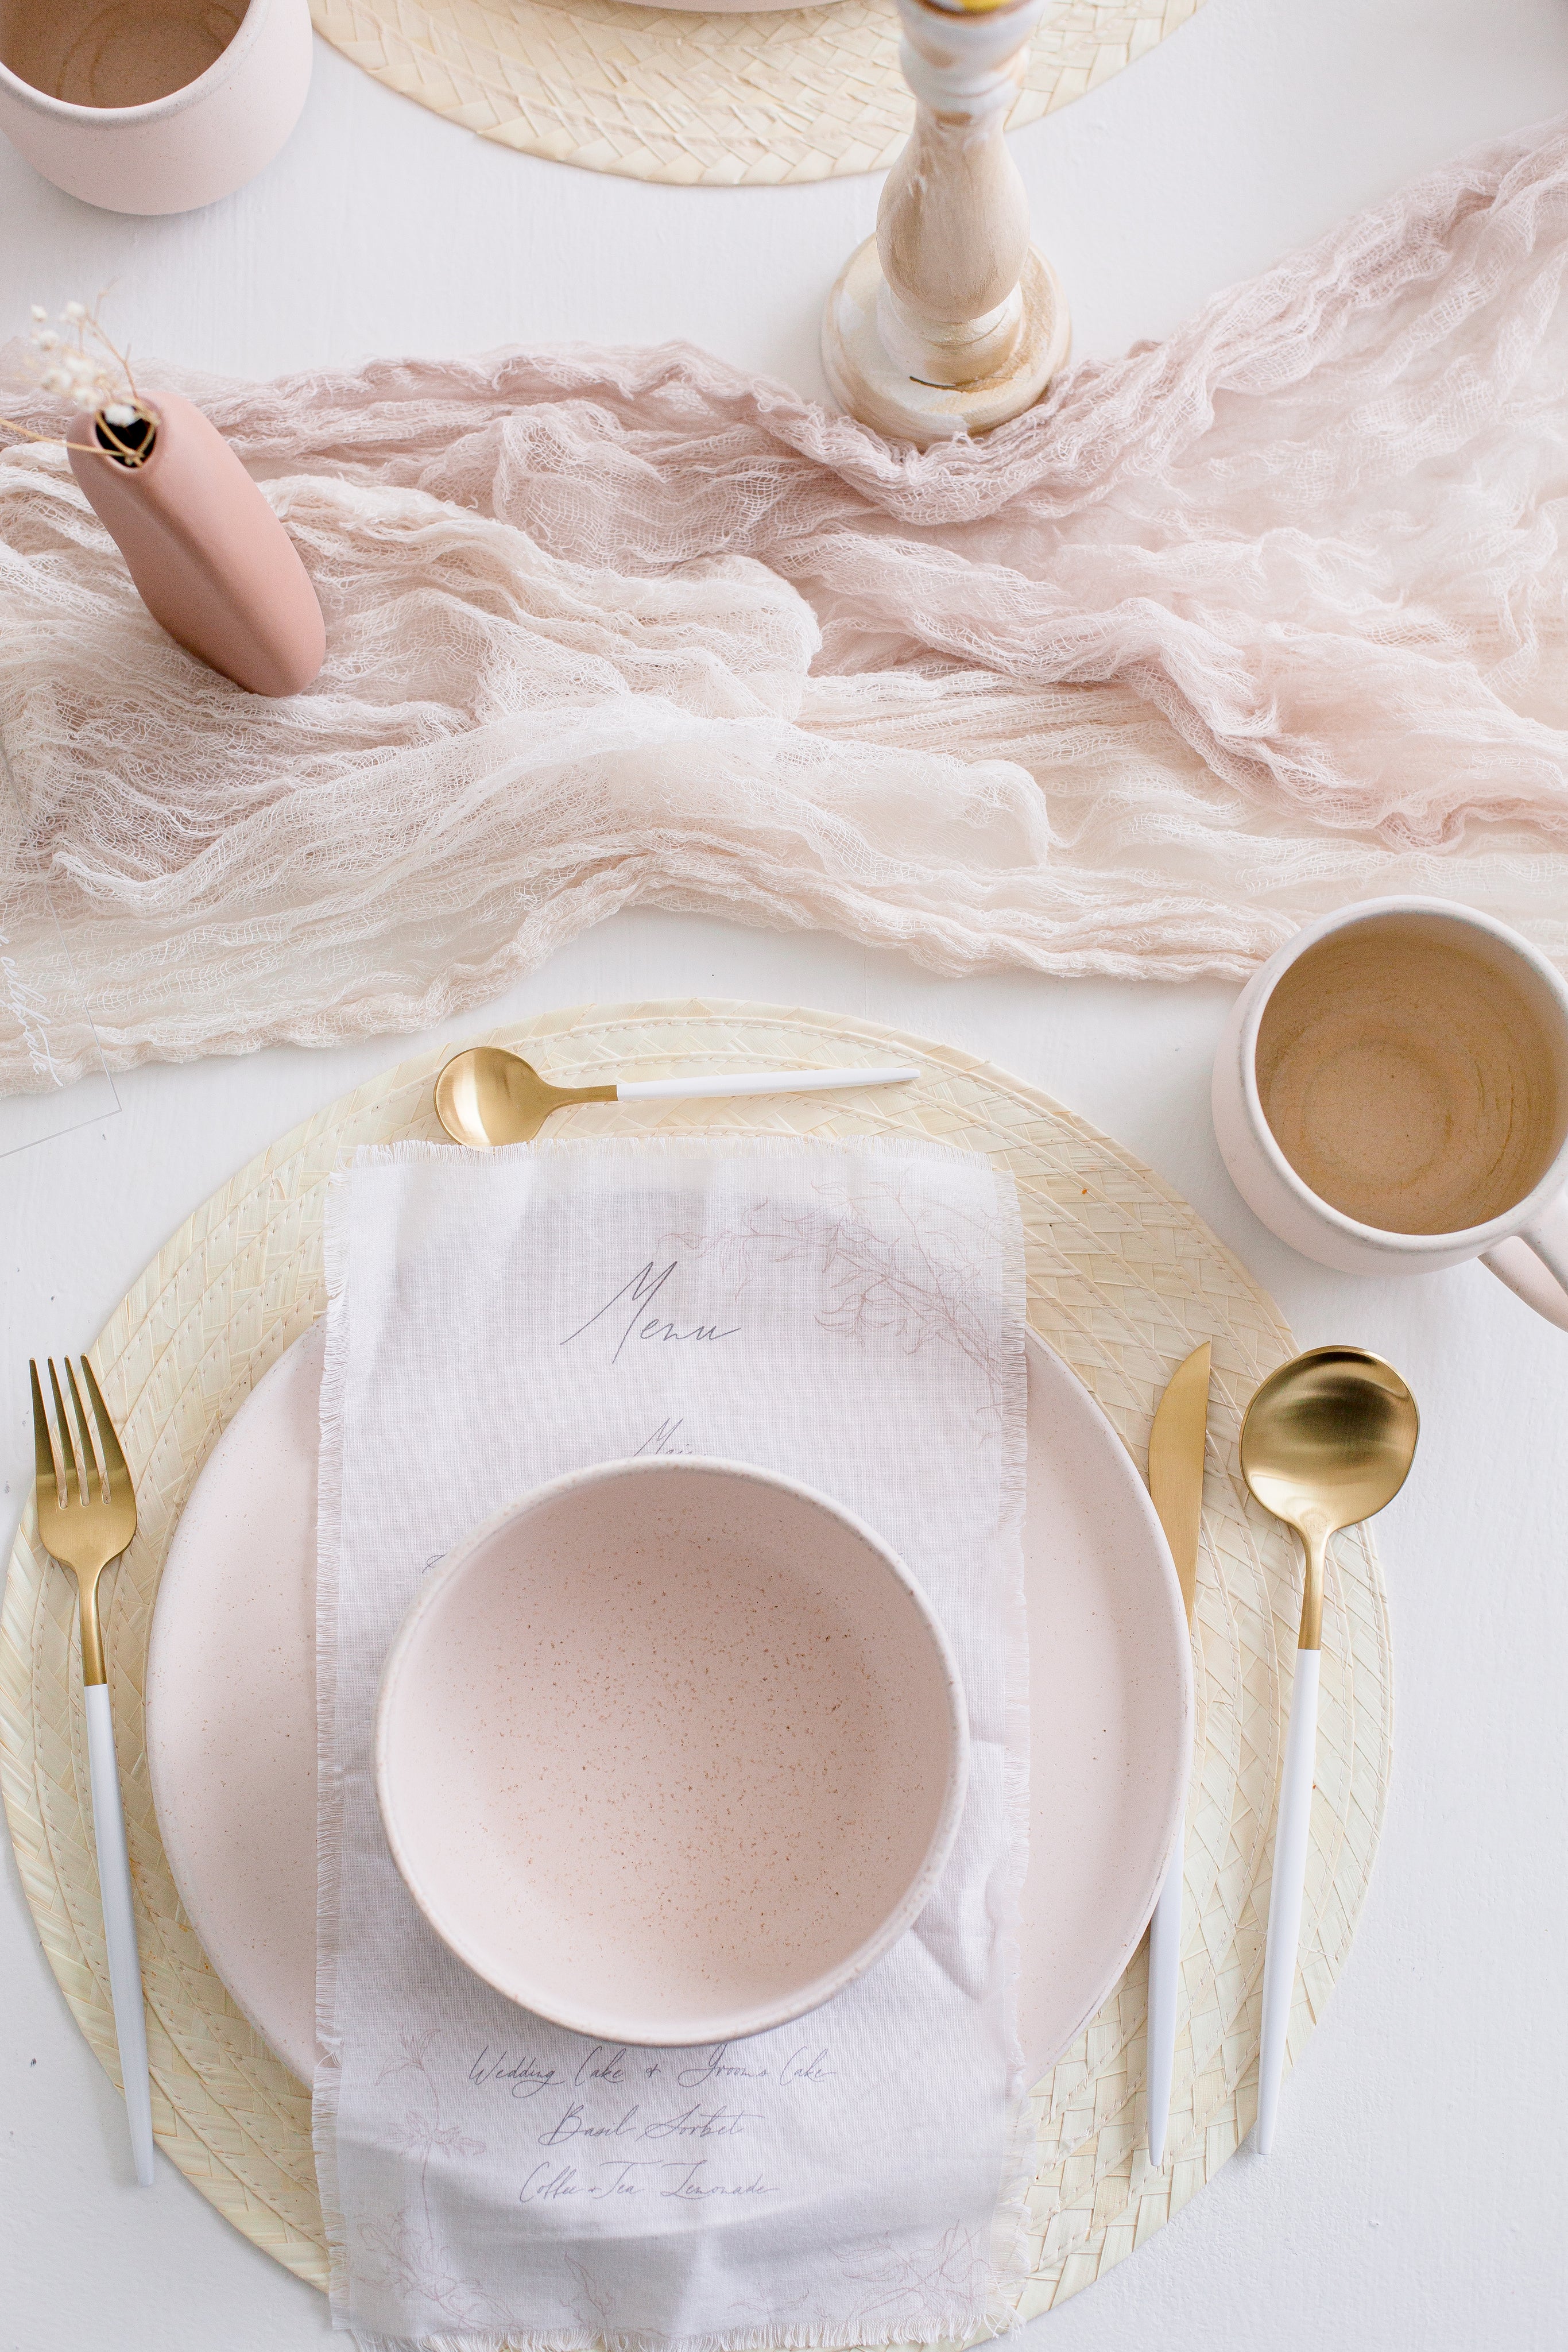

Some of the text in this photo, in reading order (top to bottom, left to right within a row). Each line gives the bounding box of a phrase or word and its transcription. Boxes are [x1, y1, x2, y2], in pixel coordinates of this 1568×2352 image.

[1, 956, 64, 1087] celebrate
[560, 1261, 741, 1364] Menu
[469, 2045, 566, 2098] Wedding
[574, 2046, 626, 2086] Cake
[779, 2046, 837, 2086] Cake
[538, 2102, 764, 2145] Basil Sorbet
[520, 2161, 585, 2203] Coffee
[593, 2160, 663, 2199] Tea
[660, 2160, 780, 2200] Lemonade
